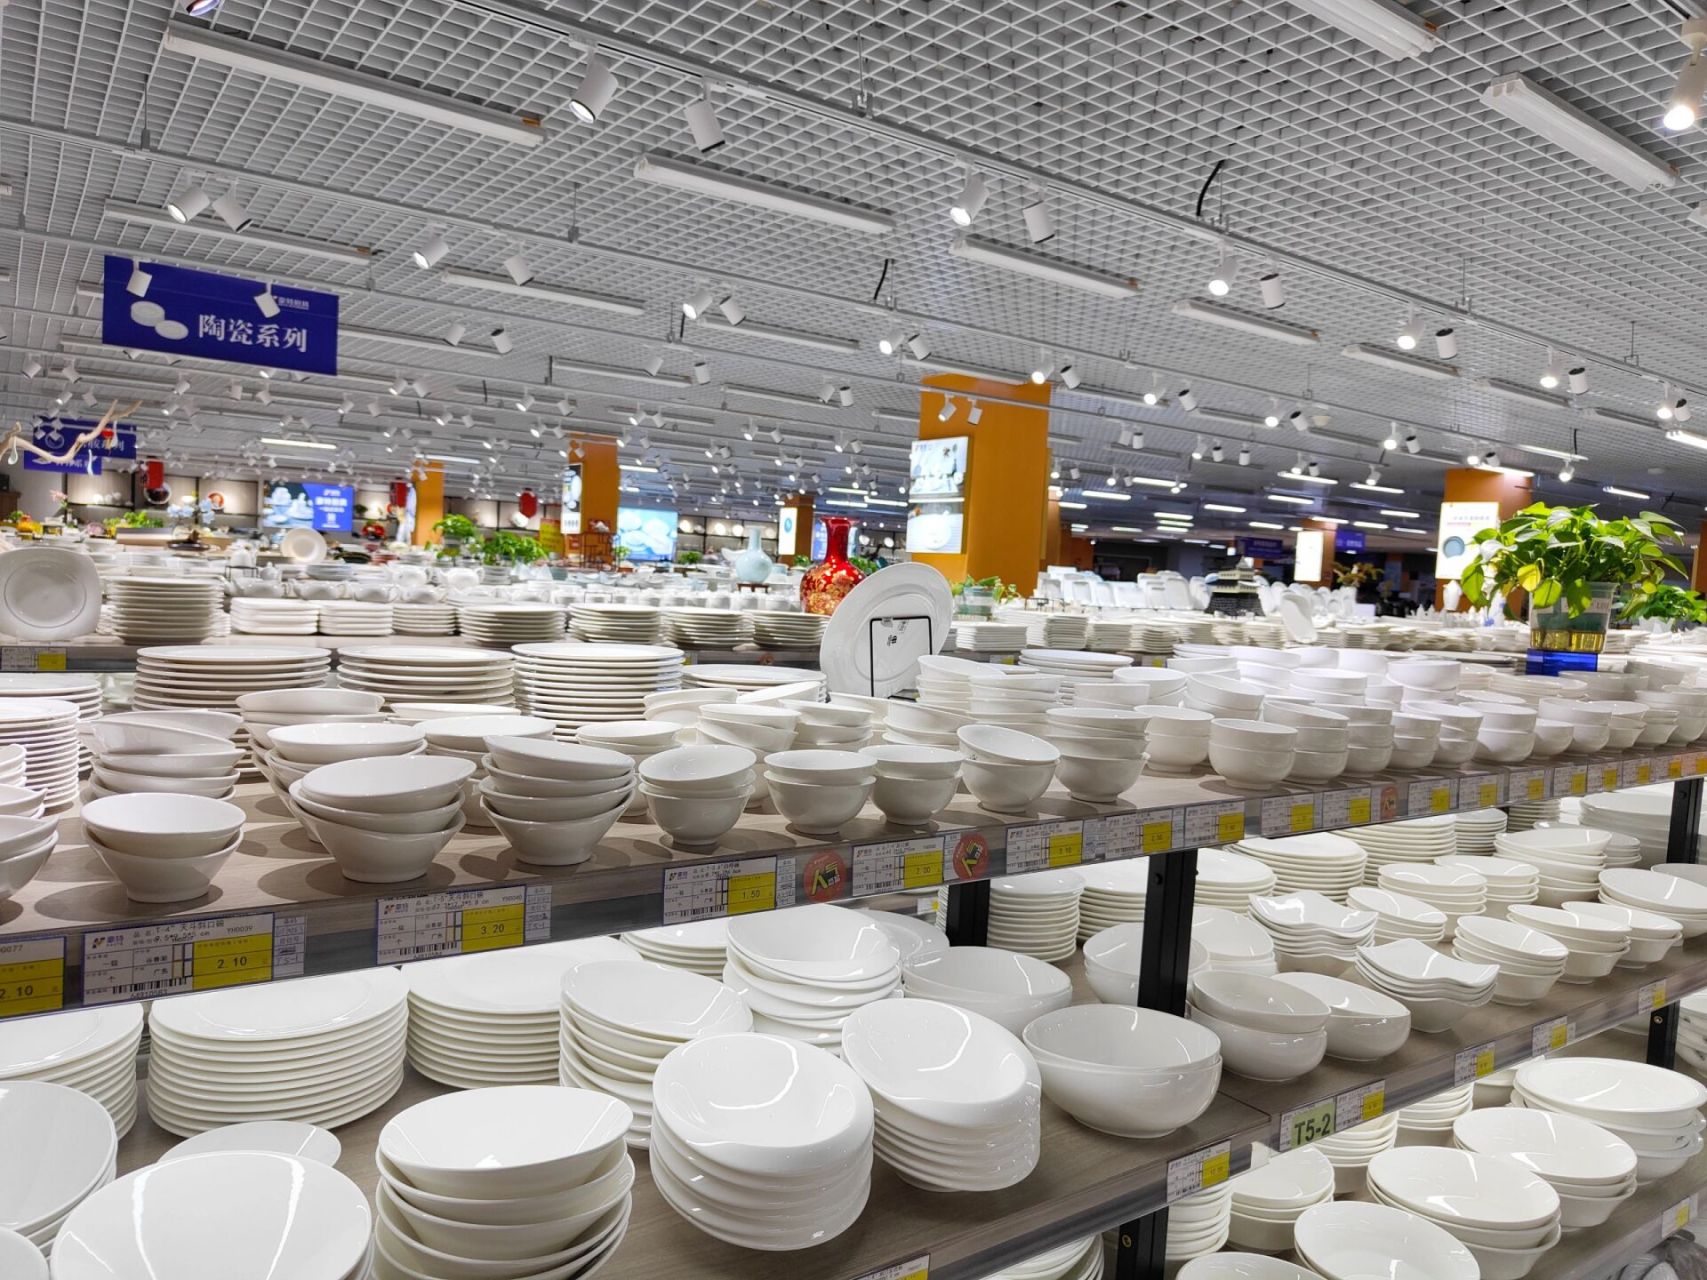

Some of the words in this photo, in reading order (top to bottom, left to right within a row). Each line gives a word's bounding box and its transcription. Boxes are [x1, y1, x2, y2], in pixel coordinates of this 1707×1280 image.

[198, 313, 308, 353] 陶瓷系列
[217, 956, 248, 969] 2.10
[1293, 1112, 1332, 1145] T5-2
